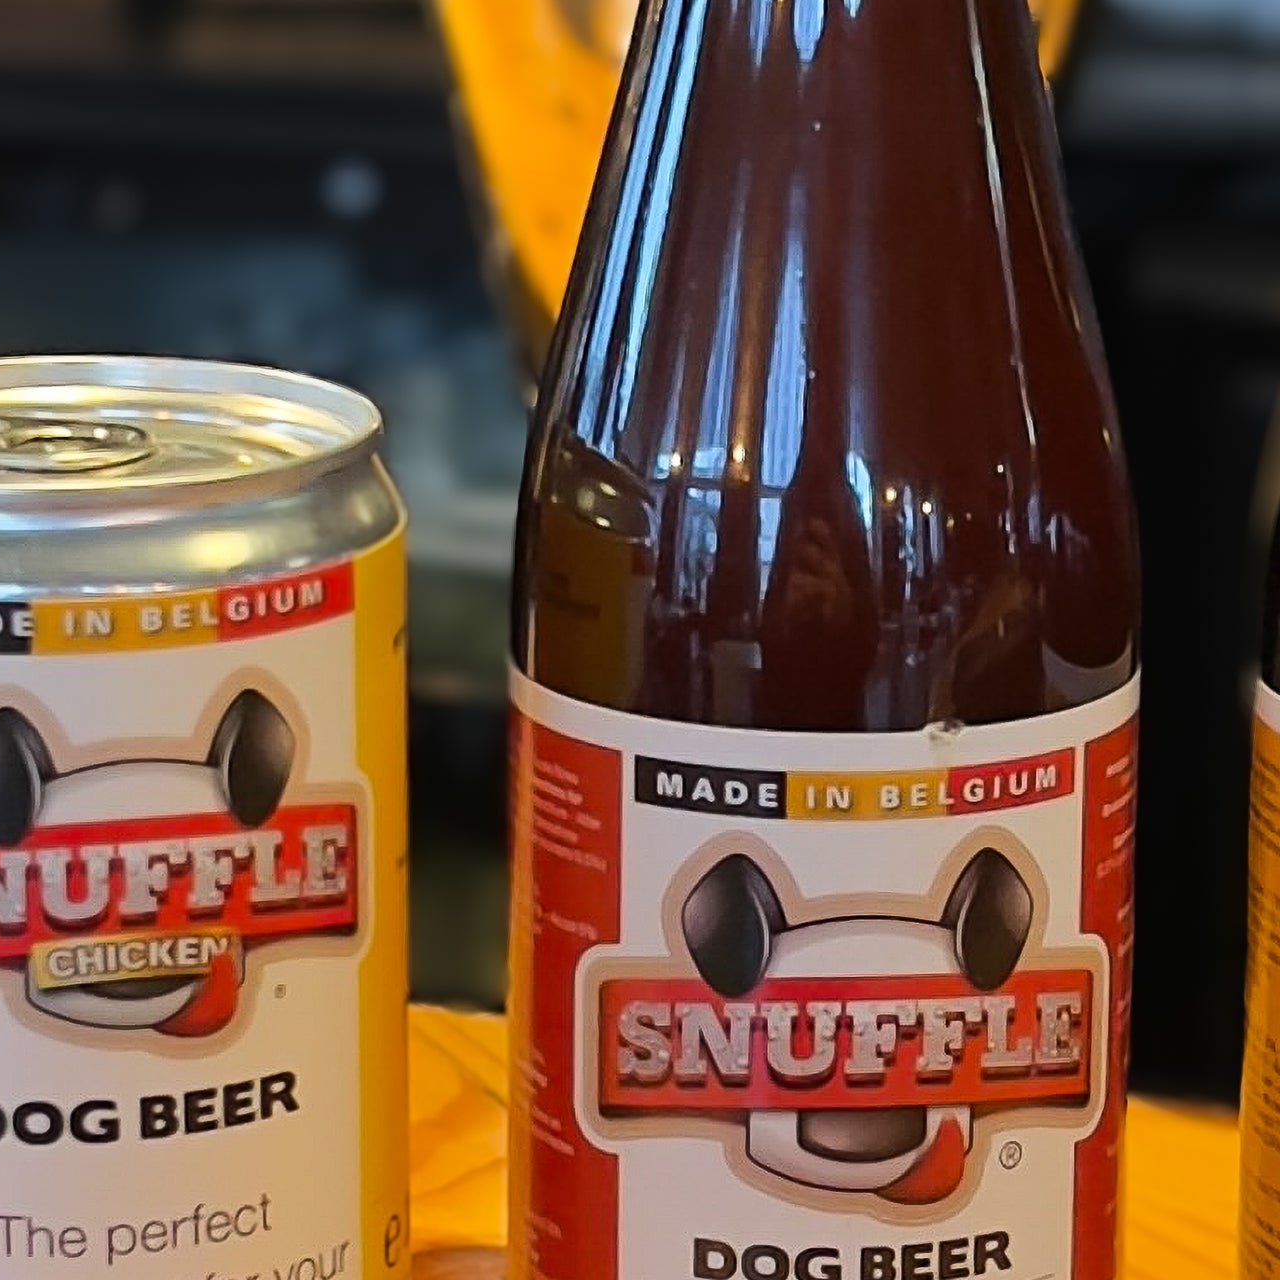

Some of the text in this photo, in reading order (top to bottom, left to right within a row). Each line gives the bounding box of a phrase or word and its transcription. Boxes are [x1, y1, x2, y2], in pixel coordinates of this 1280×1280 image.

[63, 607, 113, 637] IN
[141, 579, 325, 632] BELGIUM
[656, 764, 1058, 810] MADE IN BELGIUM
[46, 934, 232, 979] CHICKEN
[617, 995, 1083, 1088] SNUFFLE
[139, 1072, 300, 1139] BEER
[106, 1193, 273, 1265] perfect
